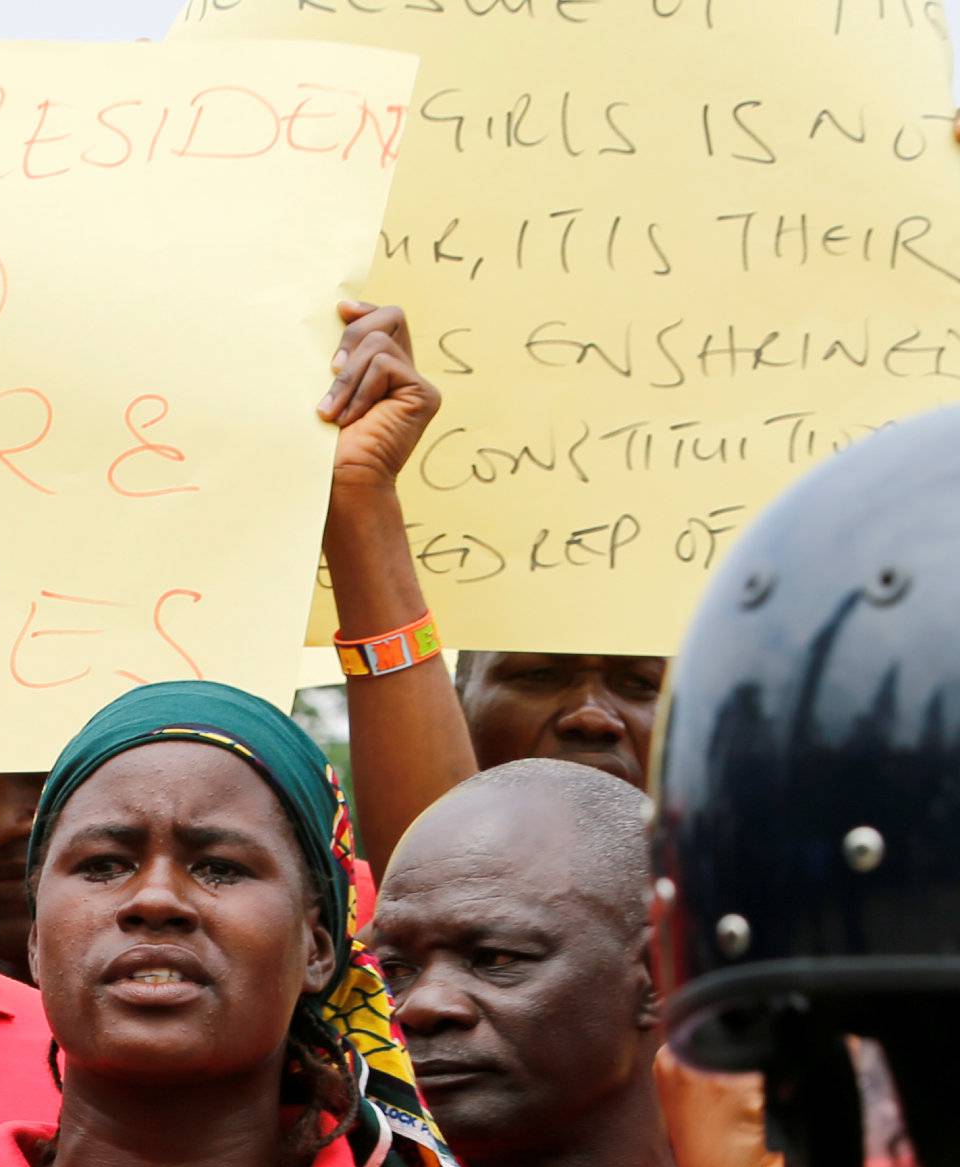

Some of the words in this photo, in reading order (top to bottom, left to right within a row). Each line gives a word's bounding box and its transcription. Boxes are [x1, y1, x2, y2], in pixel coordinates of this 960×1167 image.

[420, 87, 637, 157] GIRLS
[701, 100, 777, 164] IS
[716, 212, 960, 284] THEIR
[529, 514, 641, 571] REP
[674, 504, 746, 569] OF
